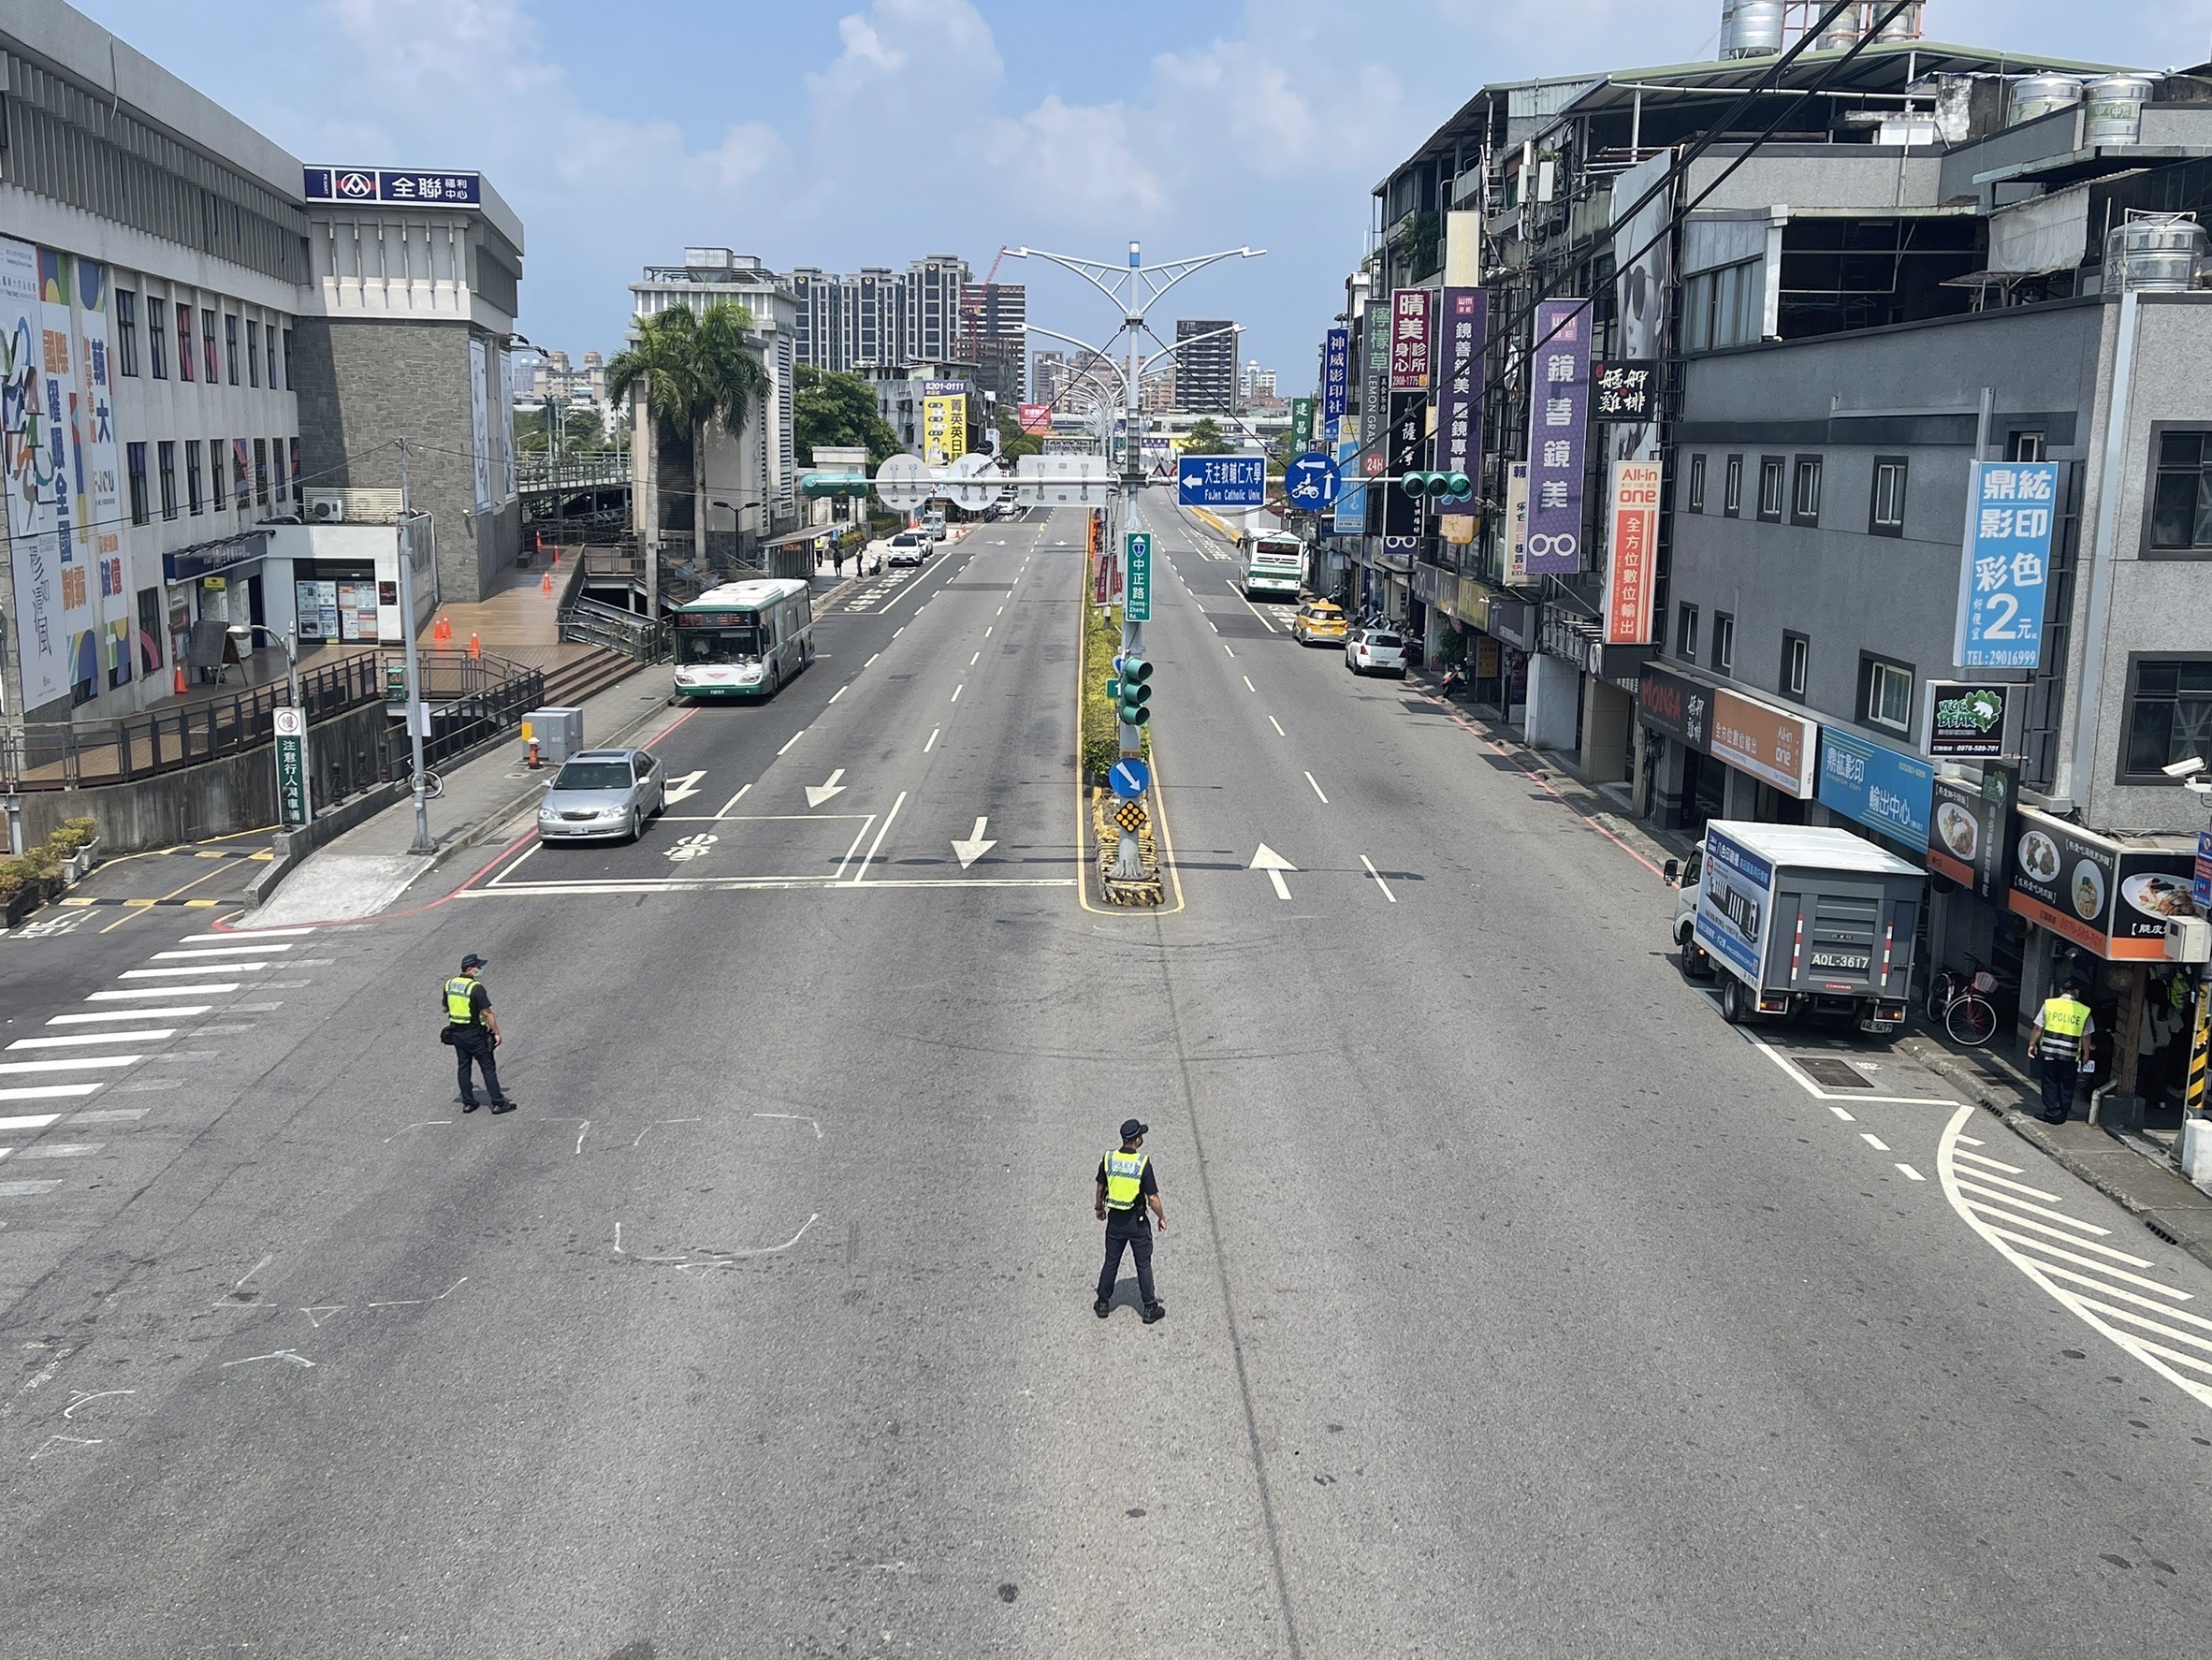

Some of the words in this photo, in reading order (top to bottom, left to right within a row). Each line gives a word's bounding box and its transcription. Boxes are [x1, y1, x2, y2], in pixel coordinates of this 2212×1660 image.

[391, 176, 443, 198] 全聯
[444, 178, 468, 189] 福利
[445, 189, 468, 199] 中心
[1398, 294, 1425, 340] 晴美
[1369, 307, 1391, 372] 檸檬草
[1394, 342, 1409, 372] 身心
[1411, 342, 1427, 372] 診所
[1453, 322, 1472, 394] 鏡善鏡美
[924, 382, 965, 391] 8201-0111
[1329, 336, 1346, 414] 神威影印社
[1392, 375, 1419, 386] 2908-1775
[1367, 375, 1377, 412] LEMON
[1598, 390, 1646, 414] 雞排
[1540, 355, 1575, 508] 鏡善鏡美
[1204, 461, 1261, 485] 天主教輔仁大學
[1366, 459, 1384, 472] 24H
[1622, 469, 1658, 481] All-in
[1204, 488, 1221, 501] FuJen
[1224, 488, 1246, 501] Catholic
[1248, 488, 1261, 501] Univ.
[1620, 489, 1657, 502] one
[1983, 470, 2053, 500] 鼎紘
[1979, 508, 2048, 539] 影印
[1132, 559, 1145, 600] 中正路
[1620, 517, 1641, 635] 全方位數位輸出
[1974, 552, 2044, 592] 彩色
[1971, 597, 1984, 641] 好便宜
[2017, 618, 2032, 639] 元
[1966, 649, 2037, 666] TEL:29016999
[1641, 673, 1681, 721] MONGA
[1938, 698, 1968, 712] VEGE
[282, 716, 294, 728] 慢
[1936, 709, 1978, 729] BEAR
[1775, 747, 1792, 767] one
[1826, 747, 1866, 784] 鼎紘影印
[1869, 784, 1911, 825] 輸出中心
[1811, 954, 1870, 969] AQL-3617
[2052, 1012, 2081, 1026] POLICE
